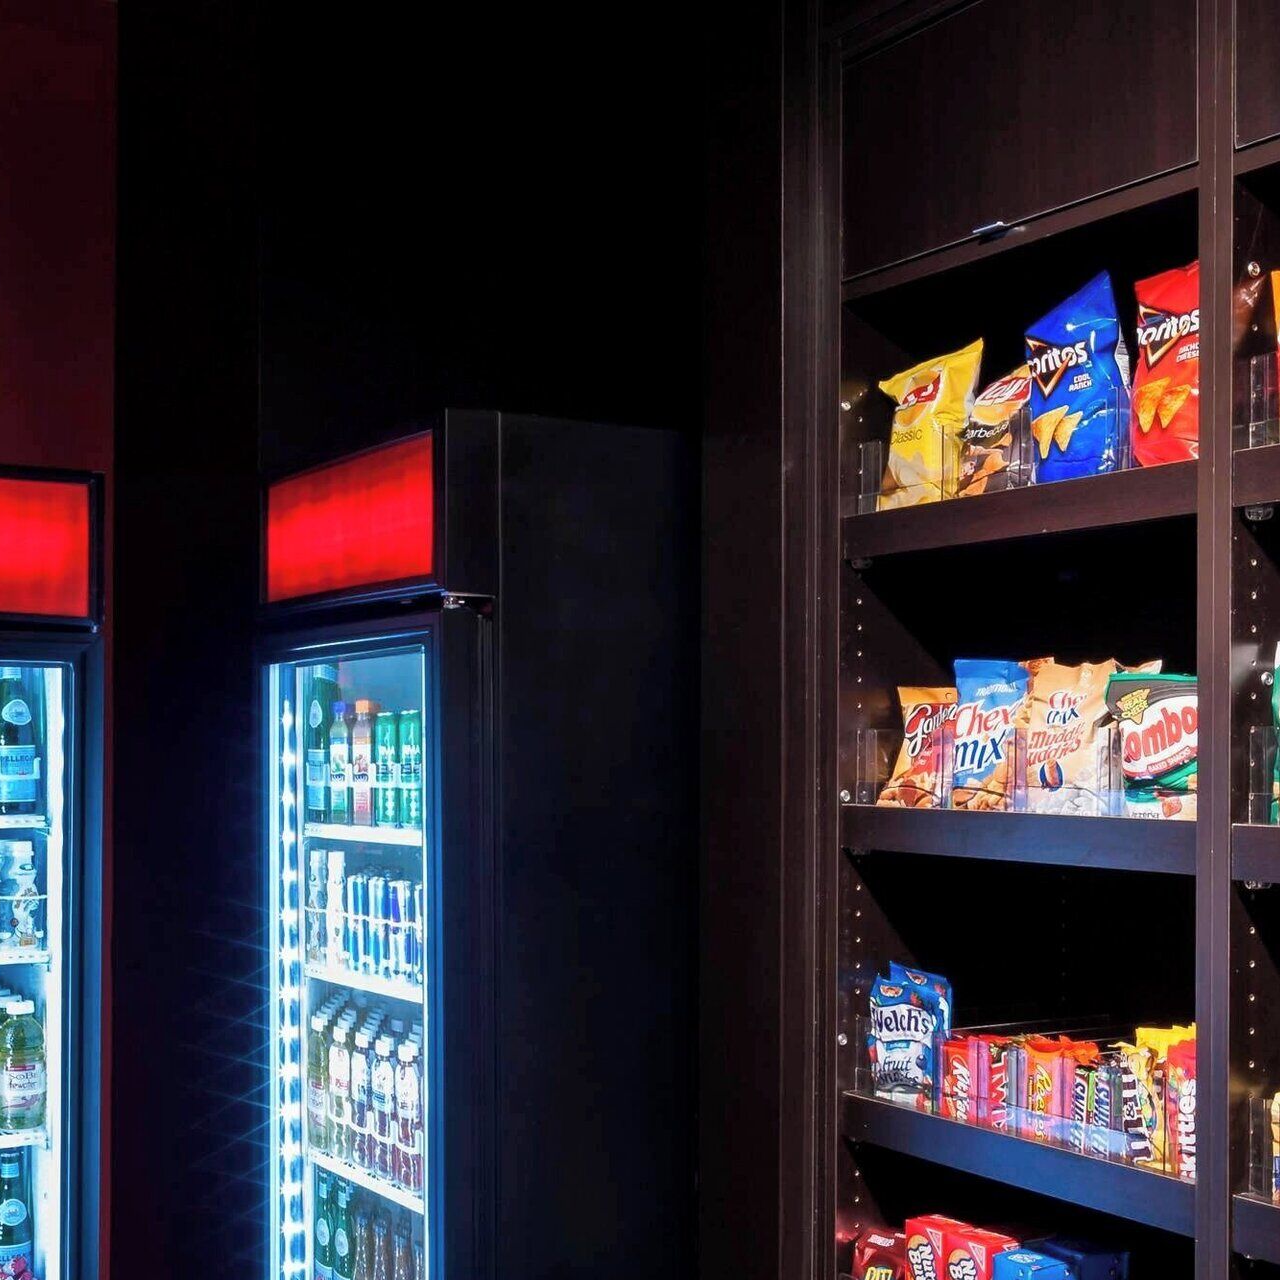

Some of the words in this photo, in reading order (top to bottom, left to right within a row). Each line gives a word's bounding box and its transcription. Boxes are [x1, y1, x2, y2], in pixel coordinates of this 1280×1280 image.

[1074, 374, 1090, 383] COOL
[1069, 380, 1092, 391] RANCH
[890, 428, 923, 444] Classic
[871, 1007, 930, 1034] Welch's
